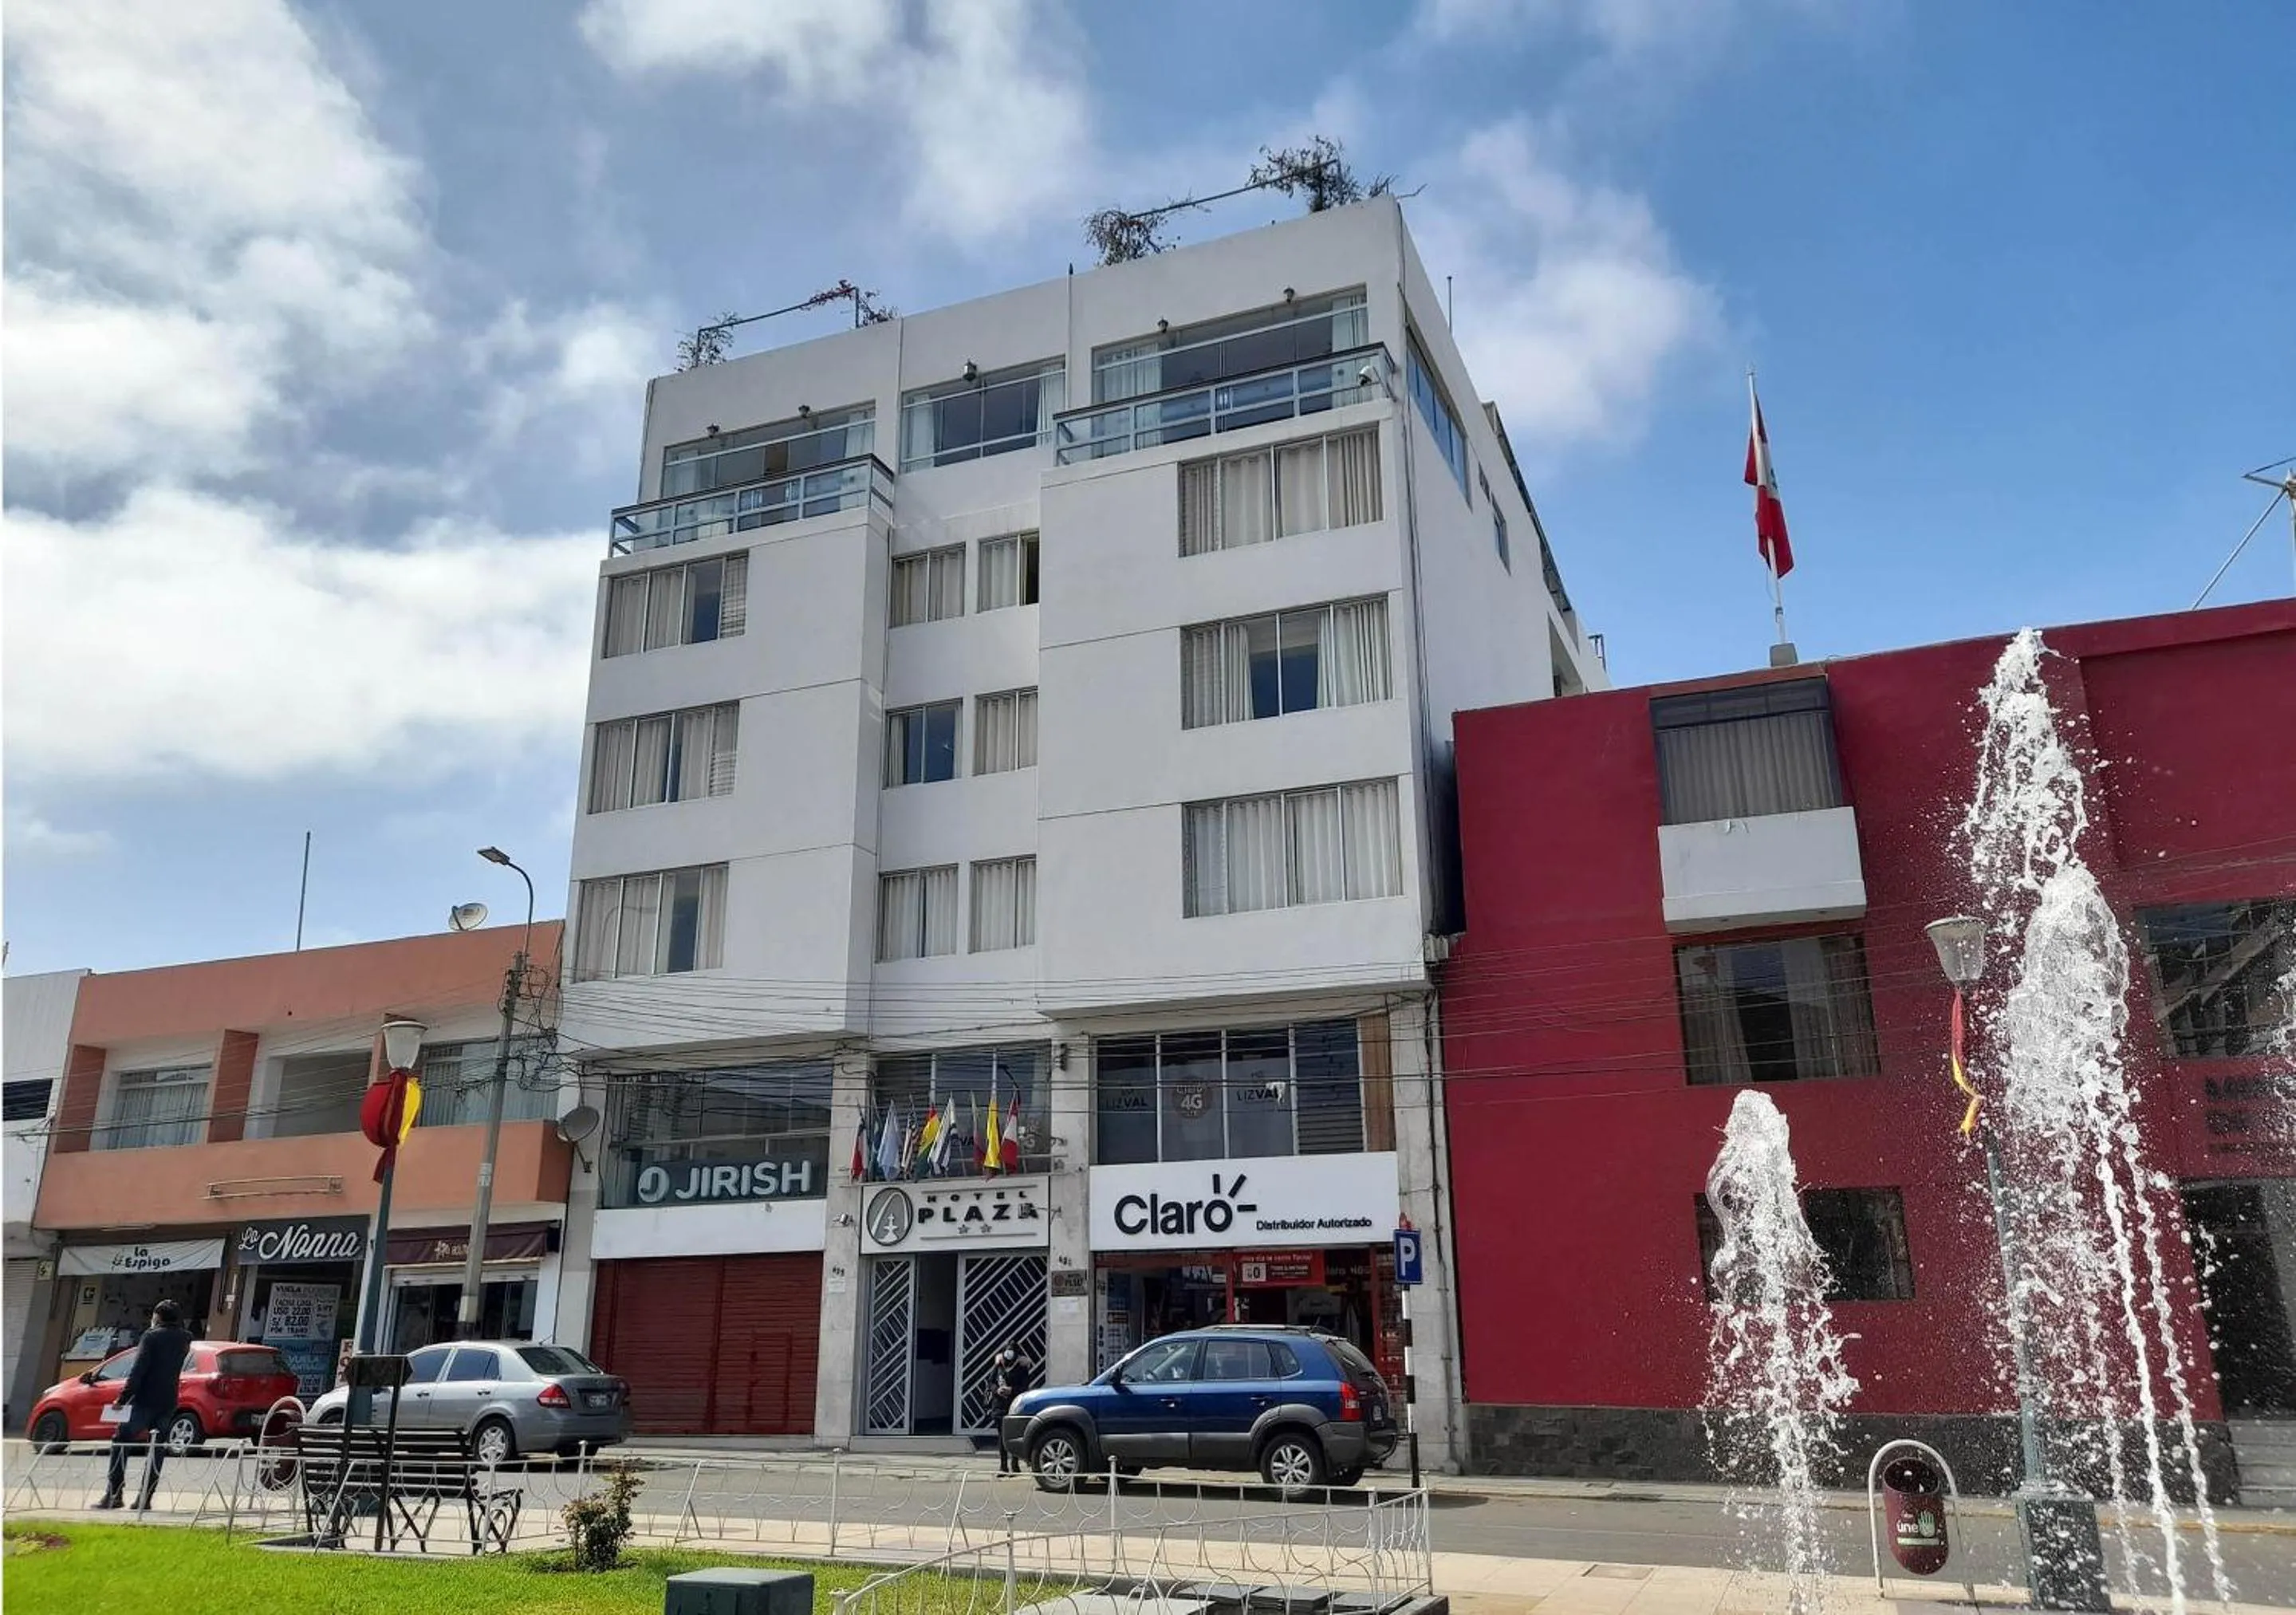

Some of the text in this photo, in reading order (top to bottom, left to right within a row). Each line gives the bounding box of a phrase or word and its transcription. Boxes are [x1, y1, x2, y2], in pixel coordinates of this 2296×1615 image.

[1181, 1093, 1203, 1110] 4G
[675, 1160, 812, 1199] JIRISH
[926, 1191, 1028, 1203] HOTEL
[917, 1203, 1038, 1223] PLAZA
[1114, 1193, 1233, 1235] Claro
[1255, 1216, 1372, 1231] Distribuidor Autorizado
[258, 1224, 360, 1260] Nonna
[1400, 1237, 1416, 1276] P
